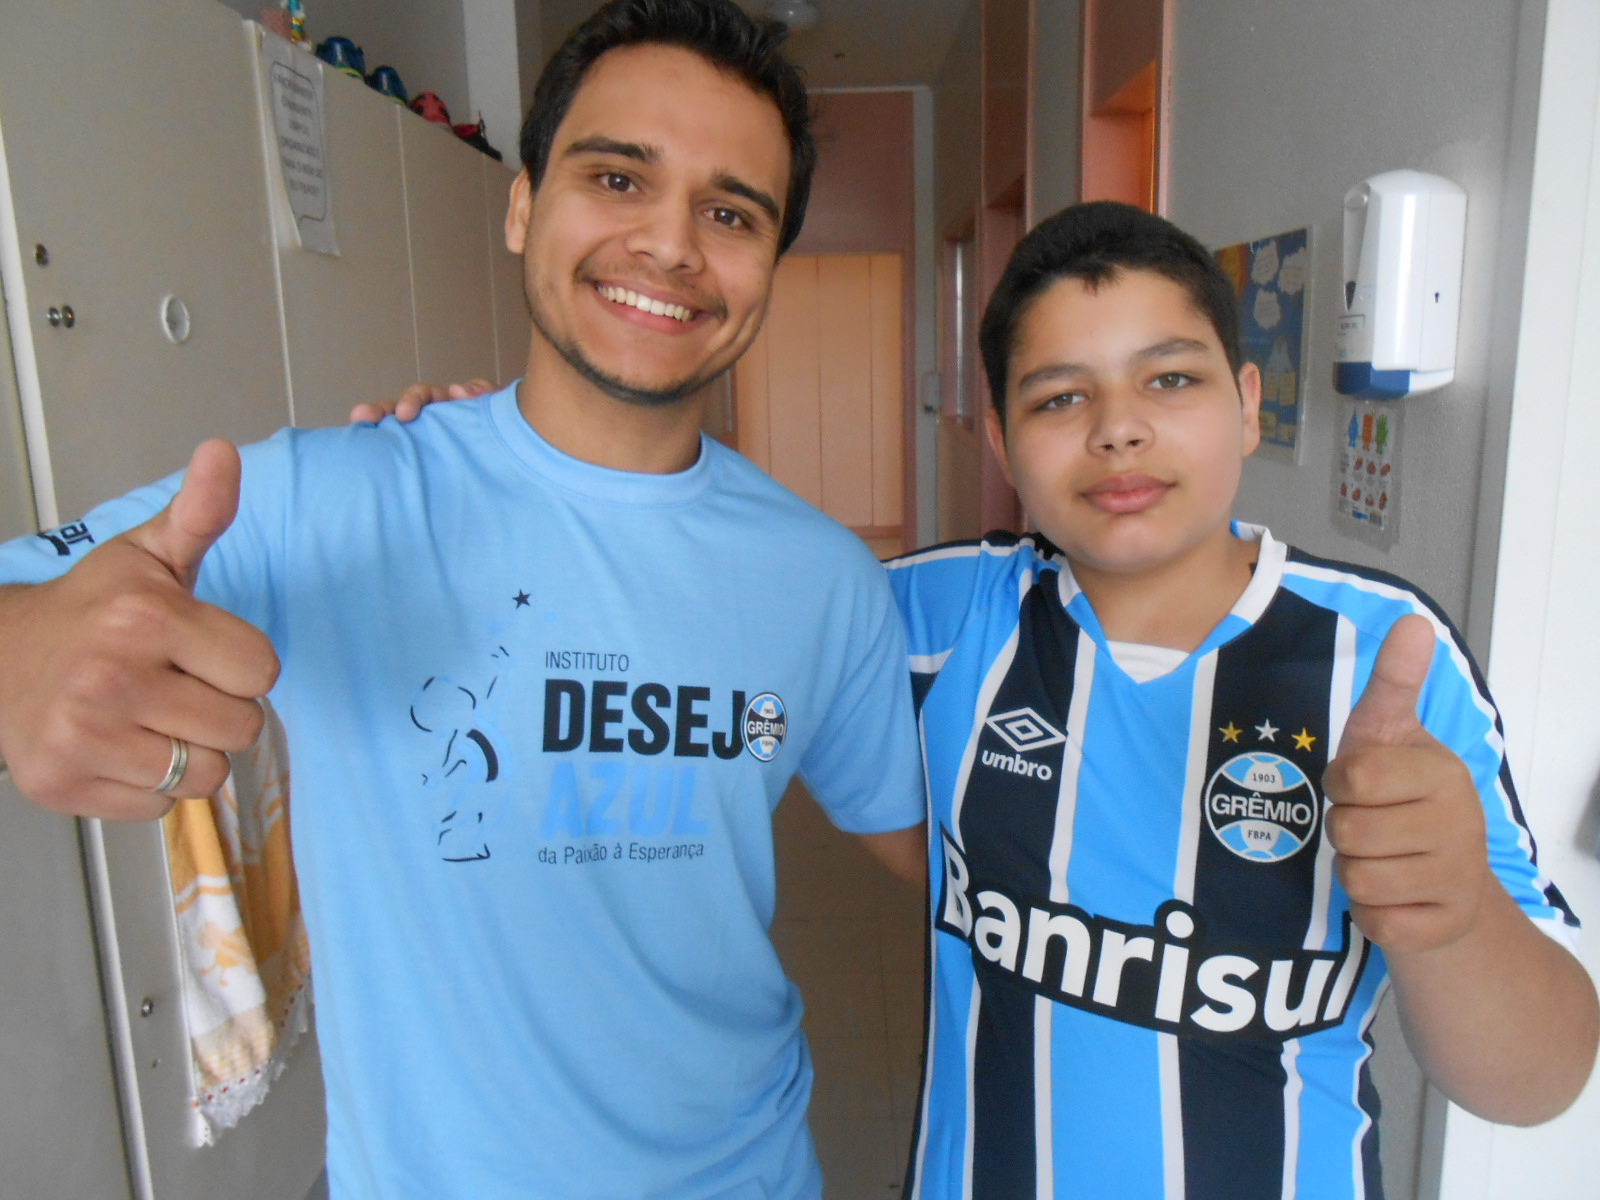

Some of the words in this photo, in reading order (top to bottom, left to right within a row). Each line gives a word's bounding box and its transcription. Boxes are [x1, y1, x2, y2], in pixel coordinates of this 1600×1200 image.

[545, 651, 629, 671] INSTITUTO
[982, 750, 1053, 781] umbro
[1251, 772, 1276, 784] 1903
[540, 762, 709, 840] AZUL
[1211, 792, 1312, 825] GRÊMIO
[1246, 829, 1272, 841] FBPA
[538, 847, 557, 864] da
[564, 843, 607, 864] Paixão
[613, 843, 623, 860] à
[629, 842, 704, 864] Esperança
[943, 833, 1366, 1033] Banrisul
